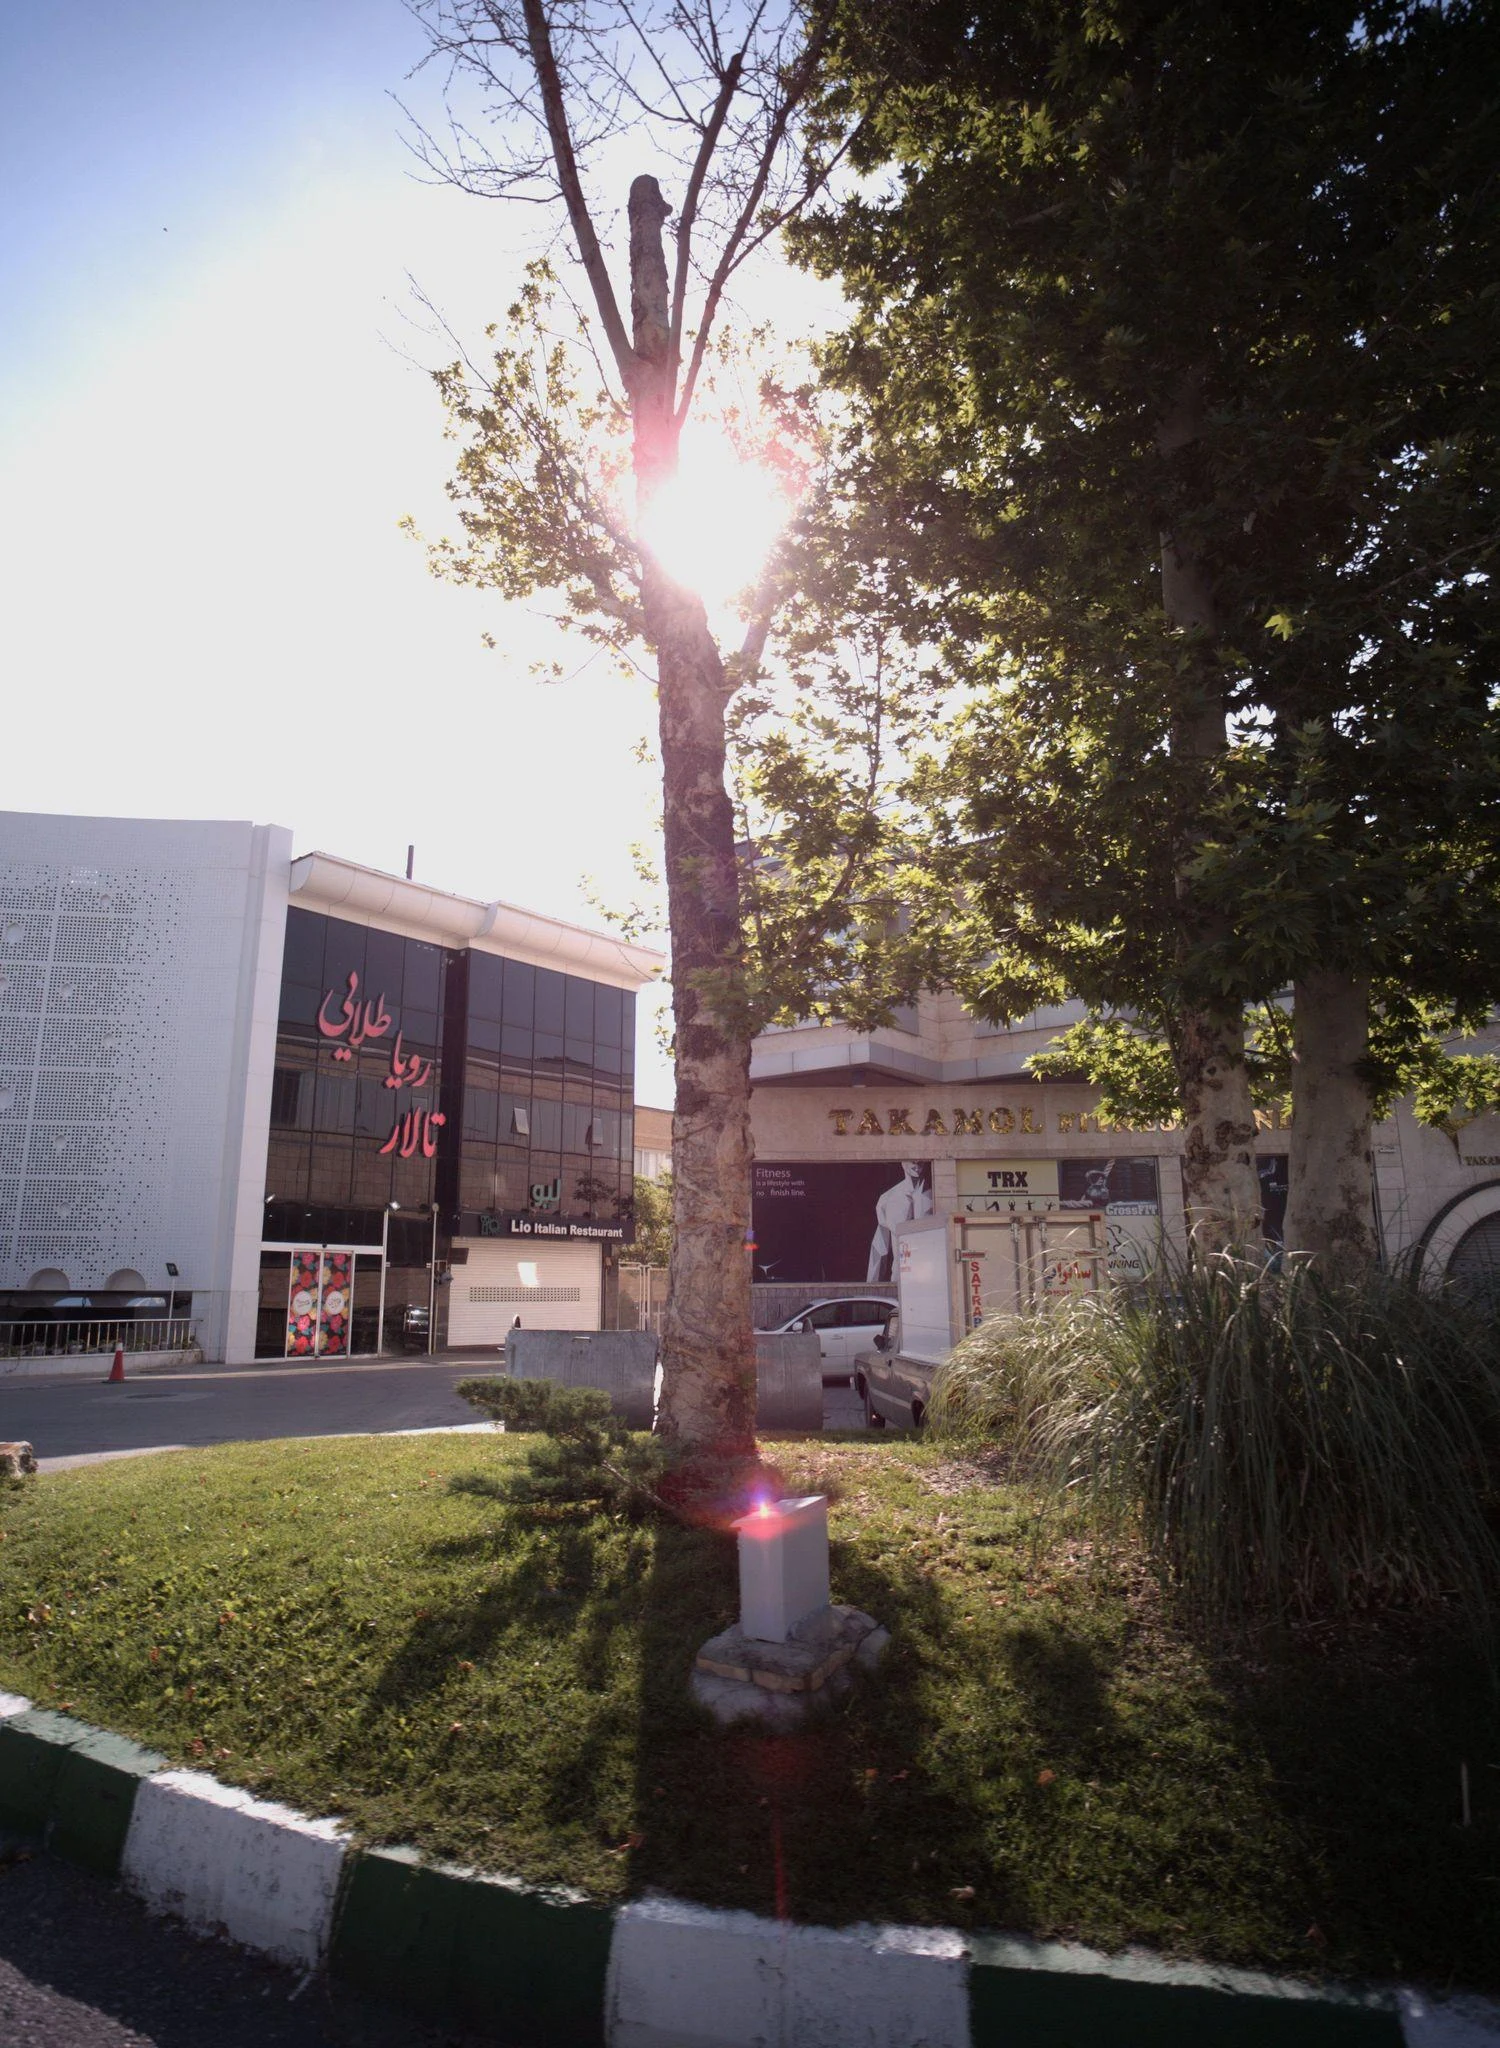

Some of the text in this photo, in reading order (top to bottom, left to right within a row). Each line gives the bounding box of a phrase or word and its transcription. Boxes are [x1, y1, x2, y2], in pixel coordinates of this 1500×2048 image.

[384, 1029, 432, 1088] رویا
[379, 1106, 446, 1158] تالار
[828, 1107, 1045, 1136] TAKAMOL
[756, 1167, 791, 1178] Fitness
[987, 1171, 1028, 1188] TRX
[511, 1219, 623, 1238] Lio Italian Restaurant
